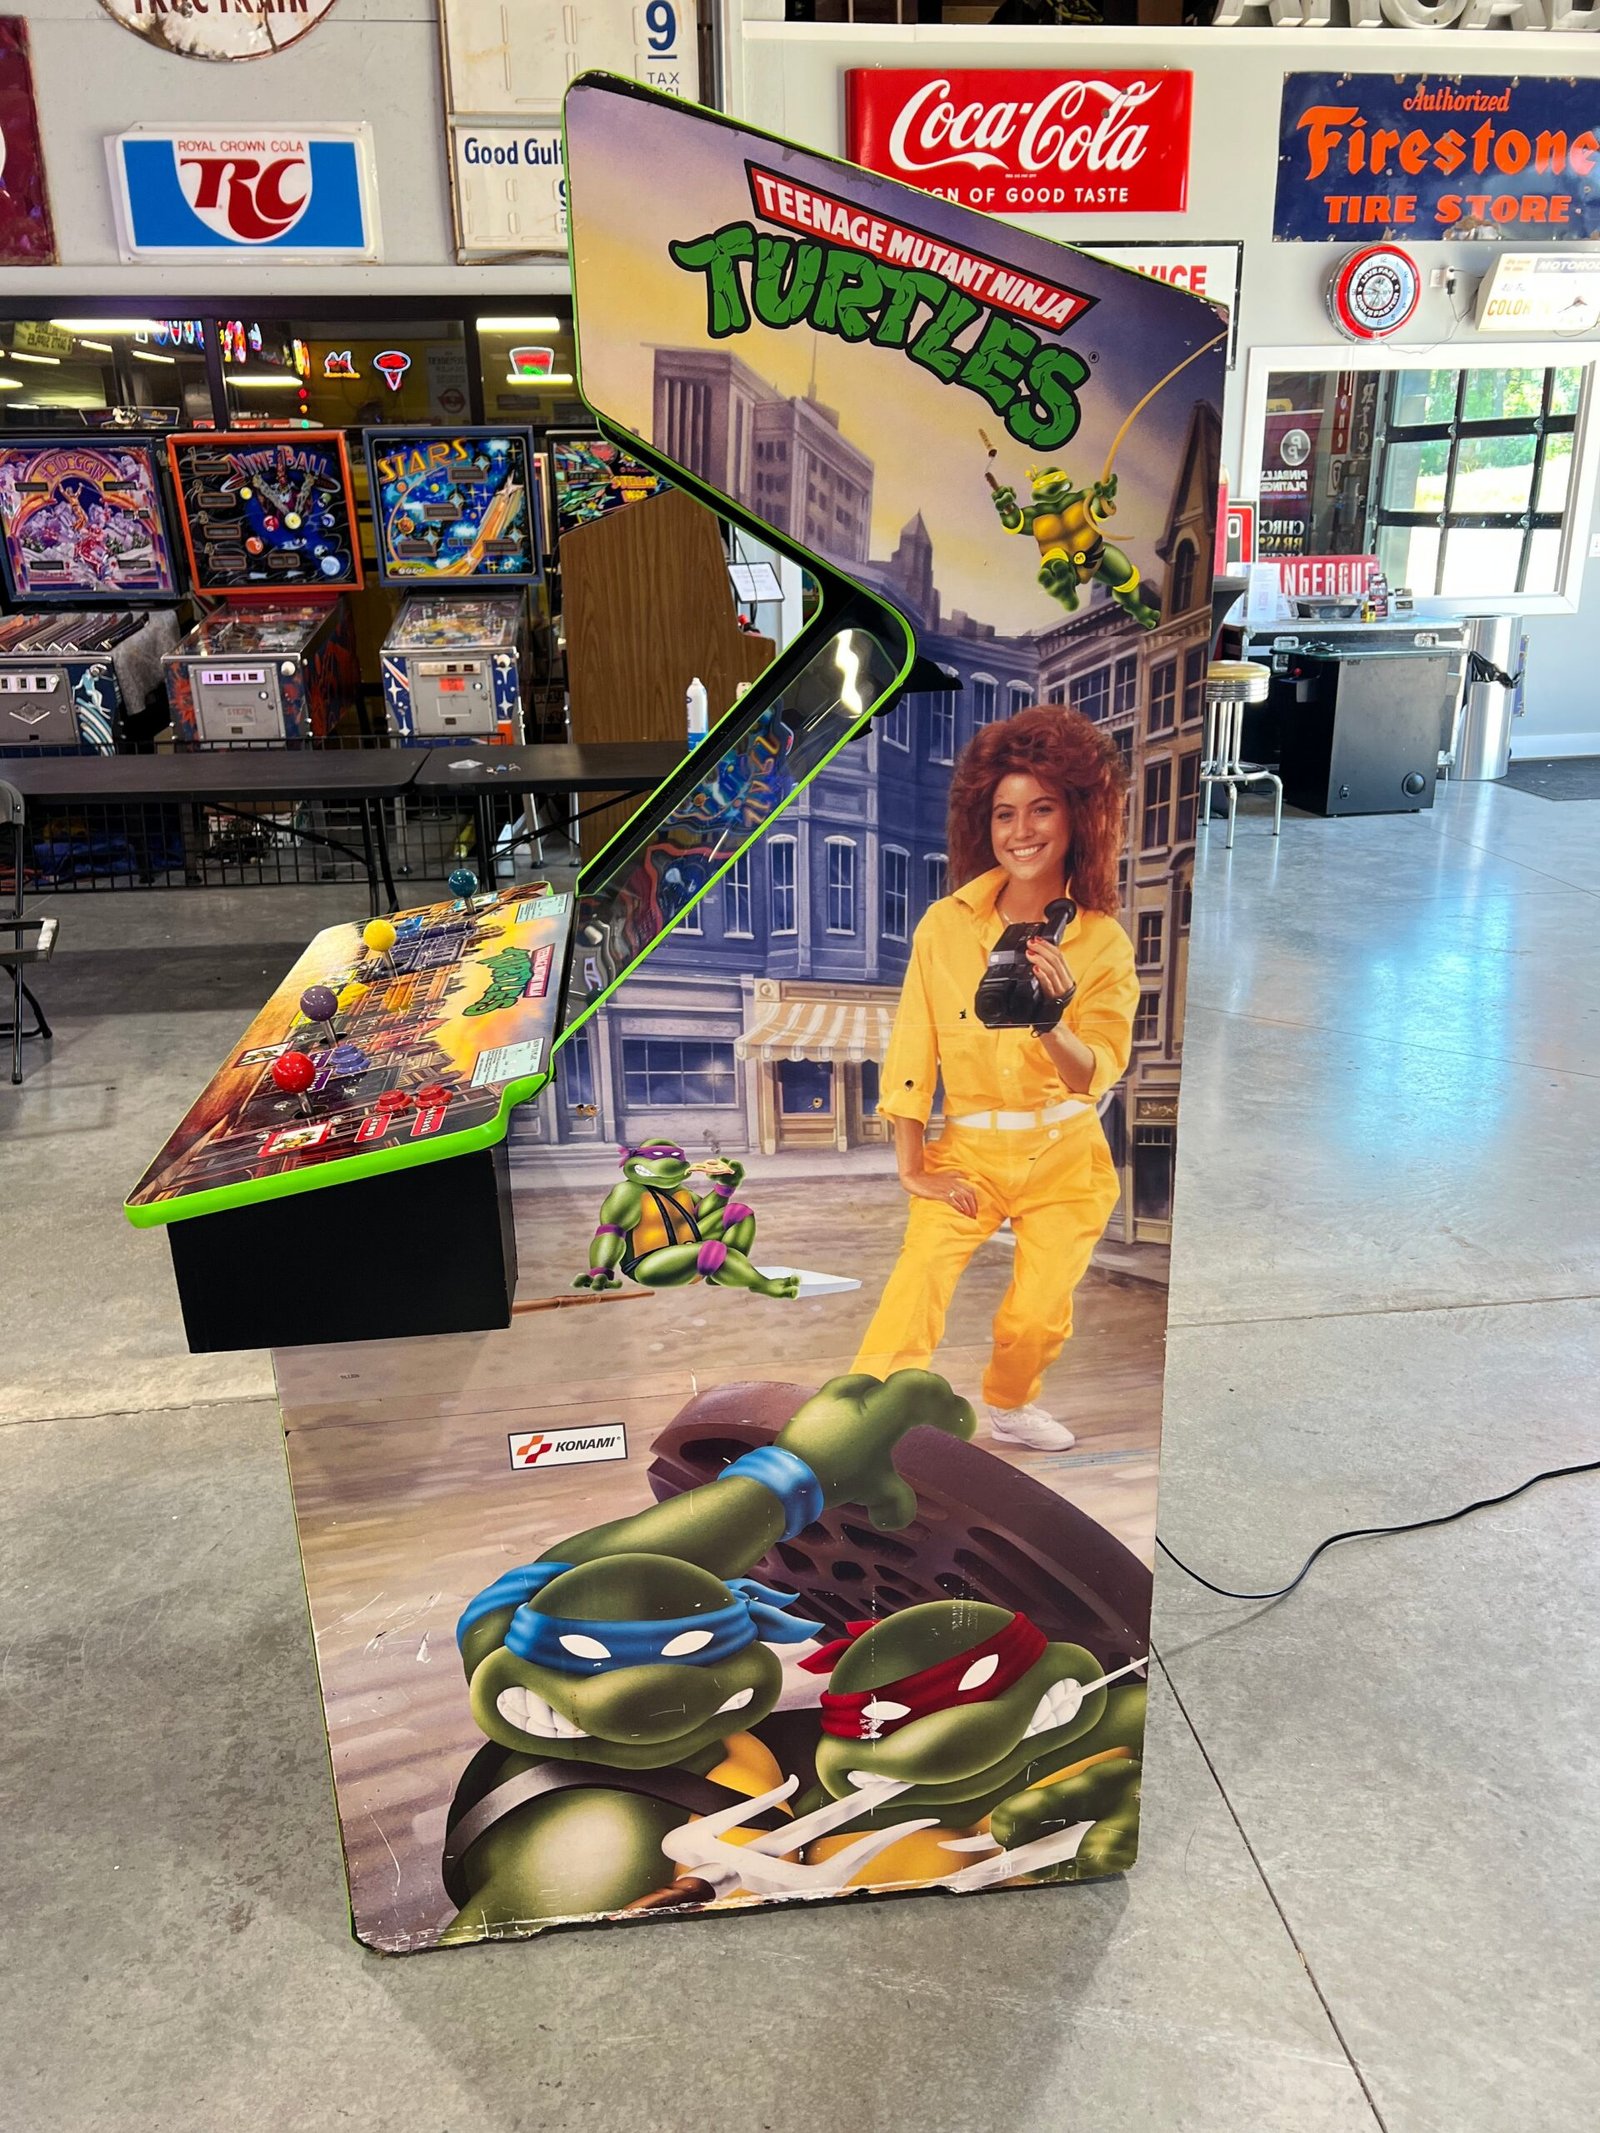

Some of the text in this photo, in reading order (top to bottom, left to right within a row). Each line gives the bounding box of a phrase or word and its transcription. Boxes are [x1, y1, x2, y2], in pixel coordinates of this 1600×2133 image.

[646, 0, 676, 51] 9
[647, 72, 680, 84] TAX
[1403, 85, 1511, 112] Authorized
[889, 79, 1163, 171] Coca-Cola
[178, 140, 305, 152] ROYAL CROWN COLA
[464, 137, 519, 164] Good
[1296, 105, 1600, 181] Firestone
[180, 158, 307, 240] RC
[969, 187, 996, 202] OF
[1005, 187, 1065, 203] GOOD
[1074, 187, 1129, 203] TASTE
[1324, 194, 1573, 224] TIRE STORE
[756, 174, 1078, 325] TEENAGE MUTANT NINJA
[669, 221, 1091, 452] TURTLES
[277, 445, 327, 474] BALL
[377, 437, 470, 485] STARS
[555, 1436, 616, 1453] KONAMI
